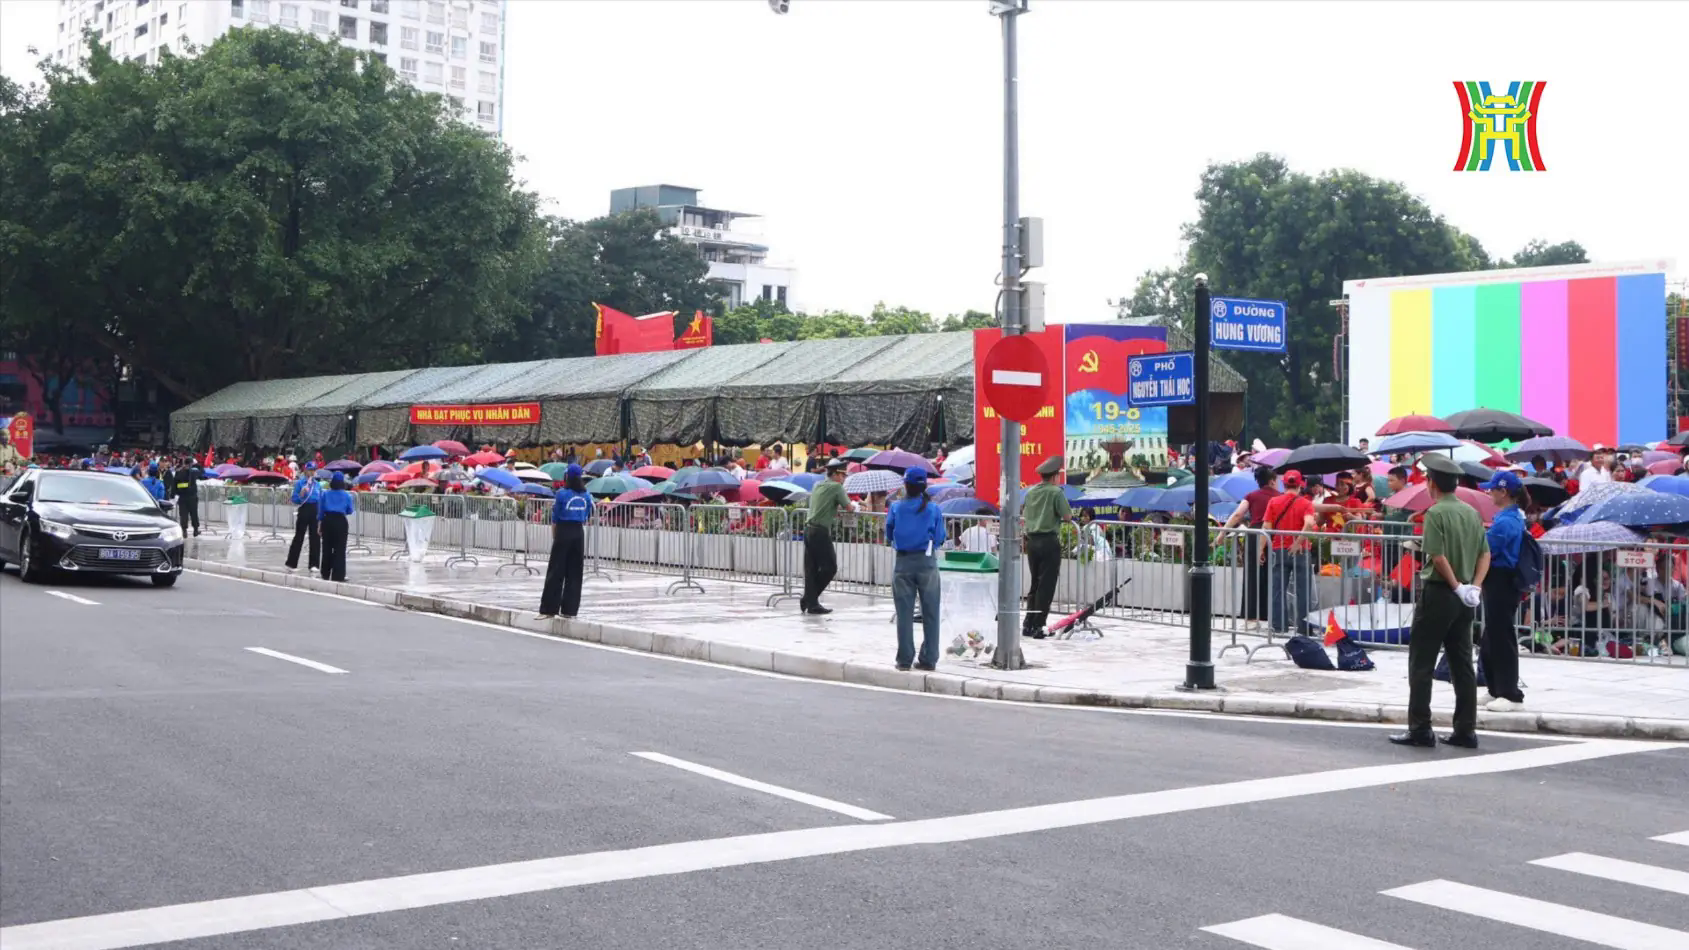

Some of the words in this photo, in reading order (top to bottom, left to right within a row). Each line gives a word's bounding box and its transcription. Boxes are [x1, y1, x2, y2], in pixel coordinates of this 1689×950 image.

[1215, 318, 1244, 341] HÙNG
[1247, 324, 1281, 344] VƯƠNG
[1154, 357, 1176, 371] PHỐ
[1132, 374, 1158, 398] NGUYỄN
[1160, 375, 1175, 397] THÁI
[1177, 377, 1191, 399] HỌC
[449, 409, 471, 422] PHỤC
[472, 409, 484, 422] VỤ
[485, 407, 510, 420] NHÂN
[512, 406, 530, 419] DÂN
